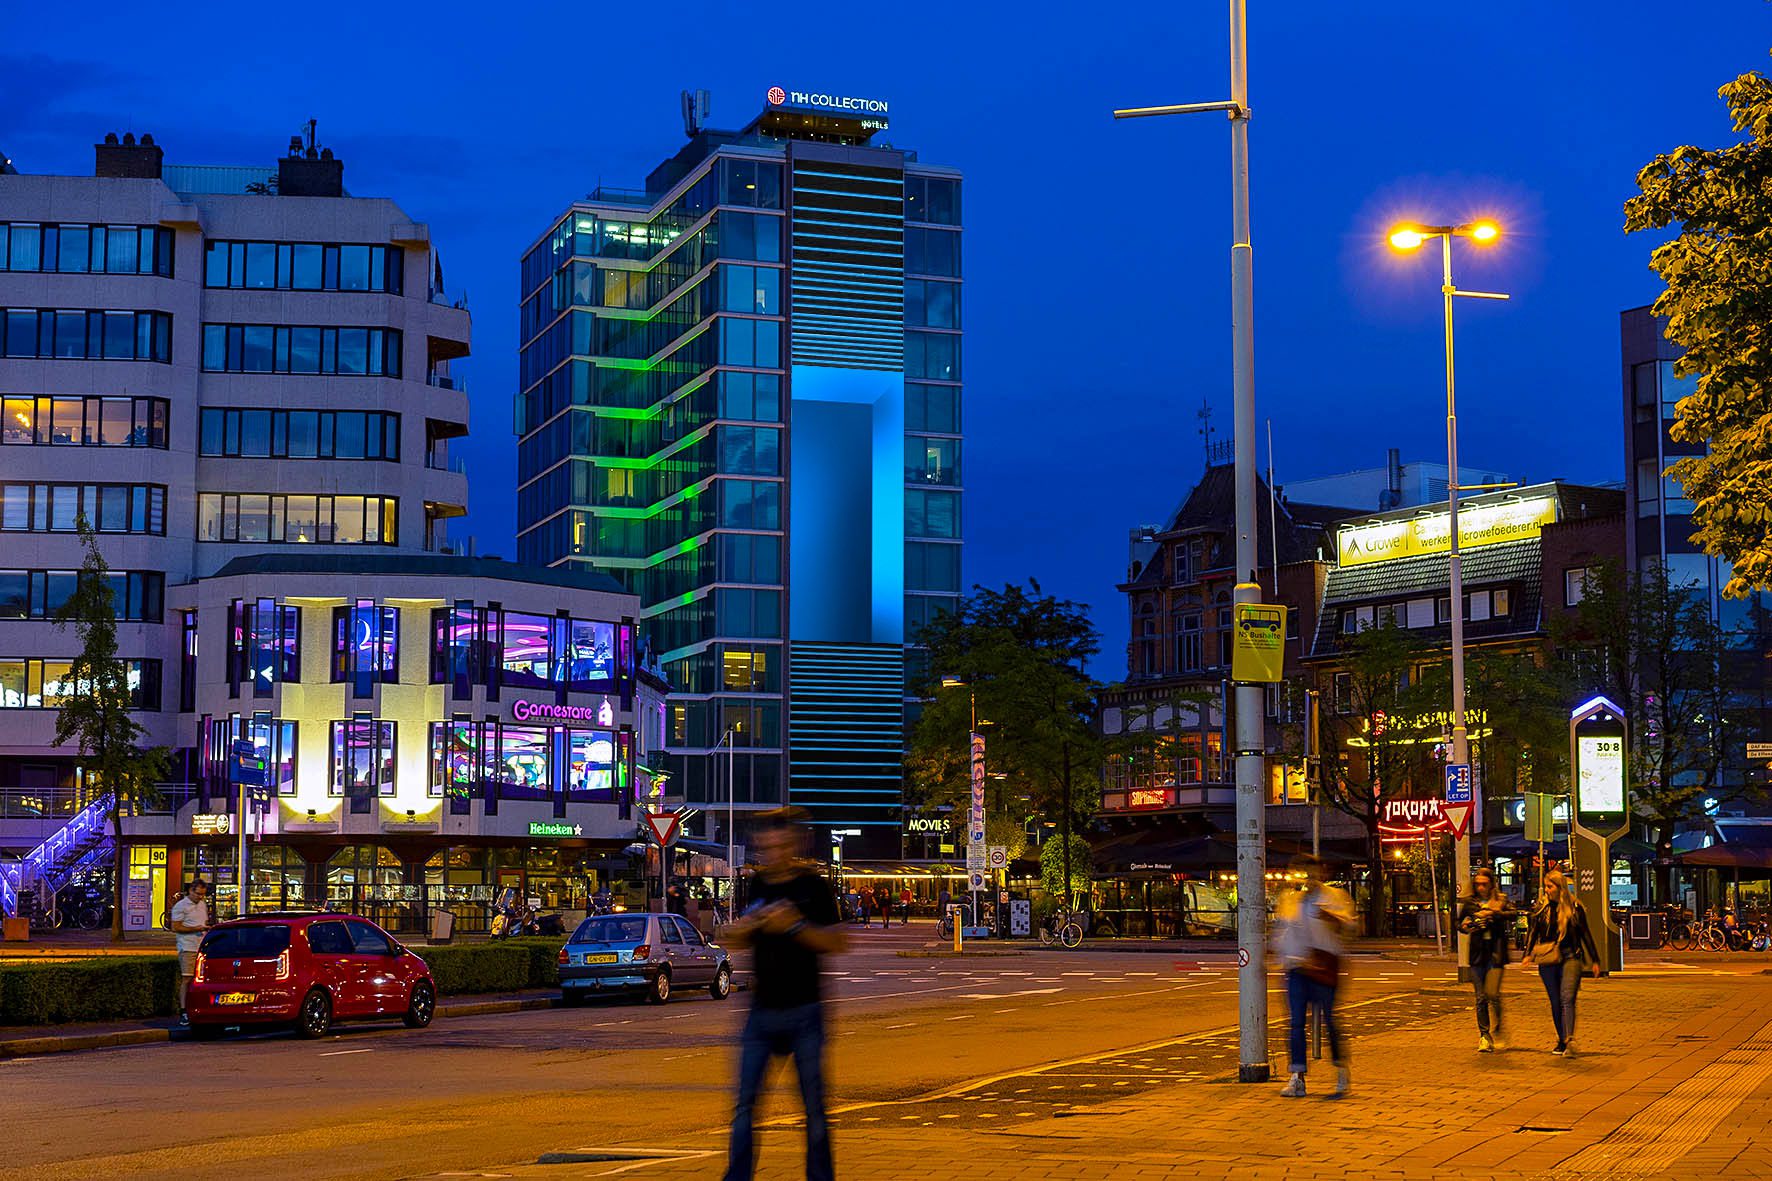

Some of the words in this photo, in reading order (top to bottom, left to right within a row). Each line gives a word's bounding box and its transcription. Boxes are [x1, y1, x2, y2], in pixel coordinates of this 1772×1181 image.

[810, 93, 888, 112] COLLECTION
[861, 120, 888, 130] HOTELS
[1365, 535, 1400, 552] Crowe
[1250, 631, 1281, 639] Bushalte
[514, 699, 593, 720] Gamestate
[529, 822, 574, 836] Heineken
[909, 819, 951, 832] MOVIES
[153, 851, 165, 861] 90
